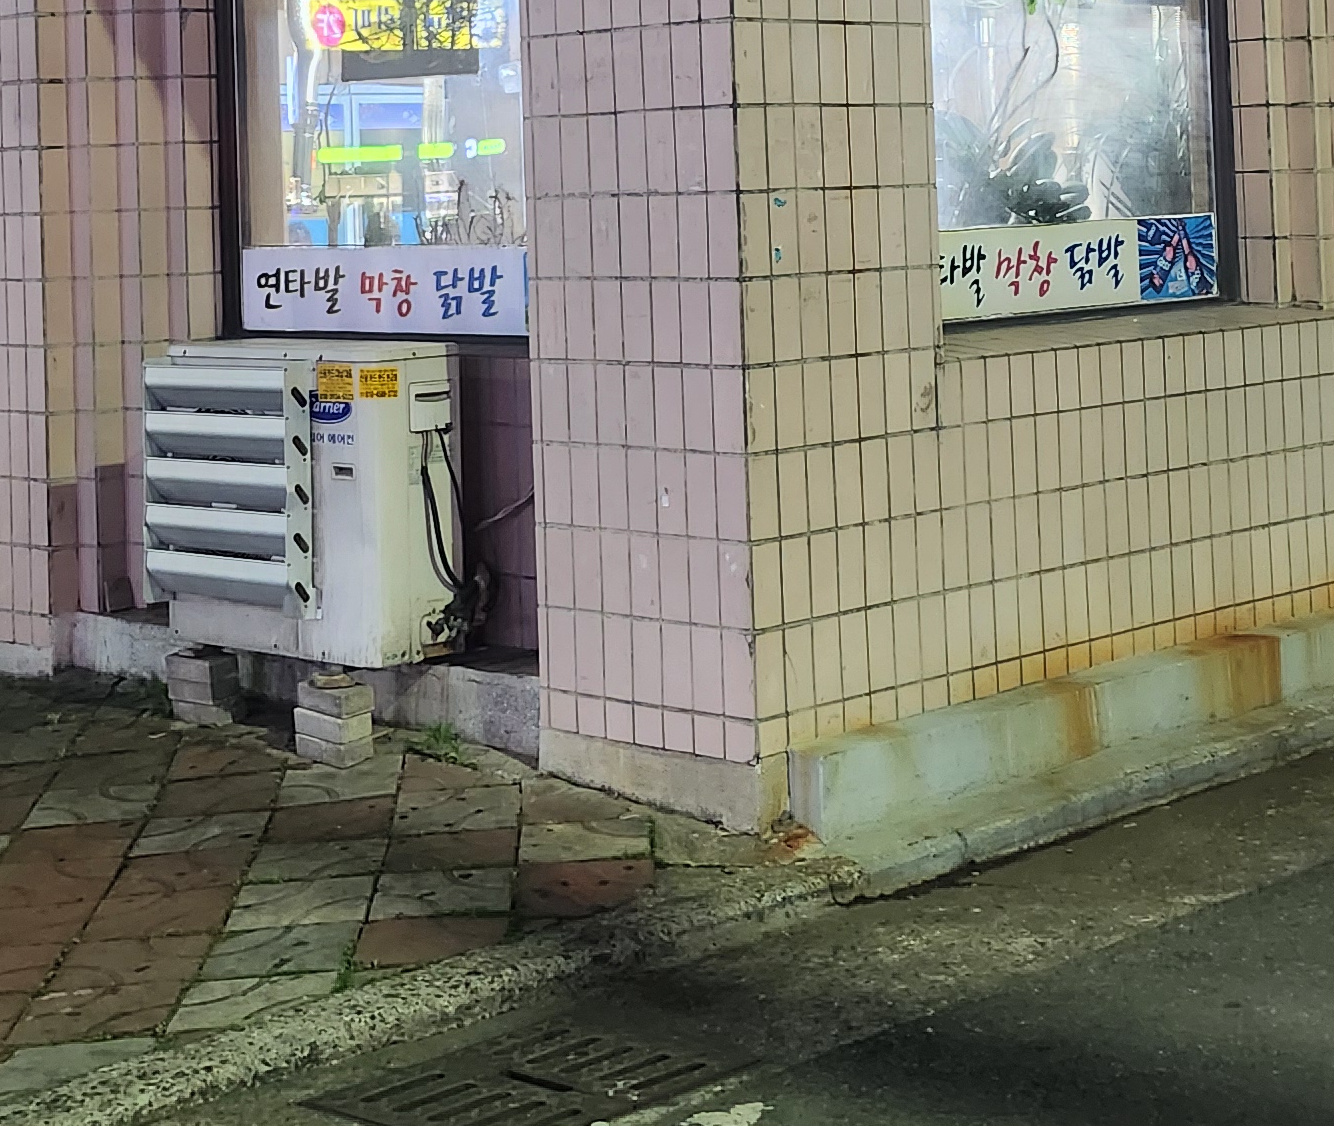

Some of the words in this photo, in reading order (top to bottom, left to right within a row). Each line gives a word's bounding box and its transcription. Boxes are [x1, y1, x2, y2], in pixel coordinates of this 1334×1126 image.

[257, 265, 346, 315] 연타발
[360, 268, 418, 318] 막창
[433, 264, 504, 319] 닭발
[994, 240, 1059, 298] 막창
[327, 434, 354, 445] 에어컨
